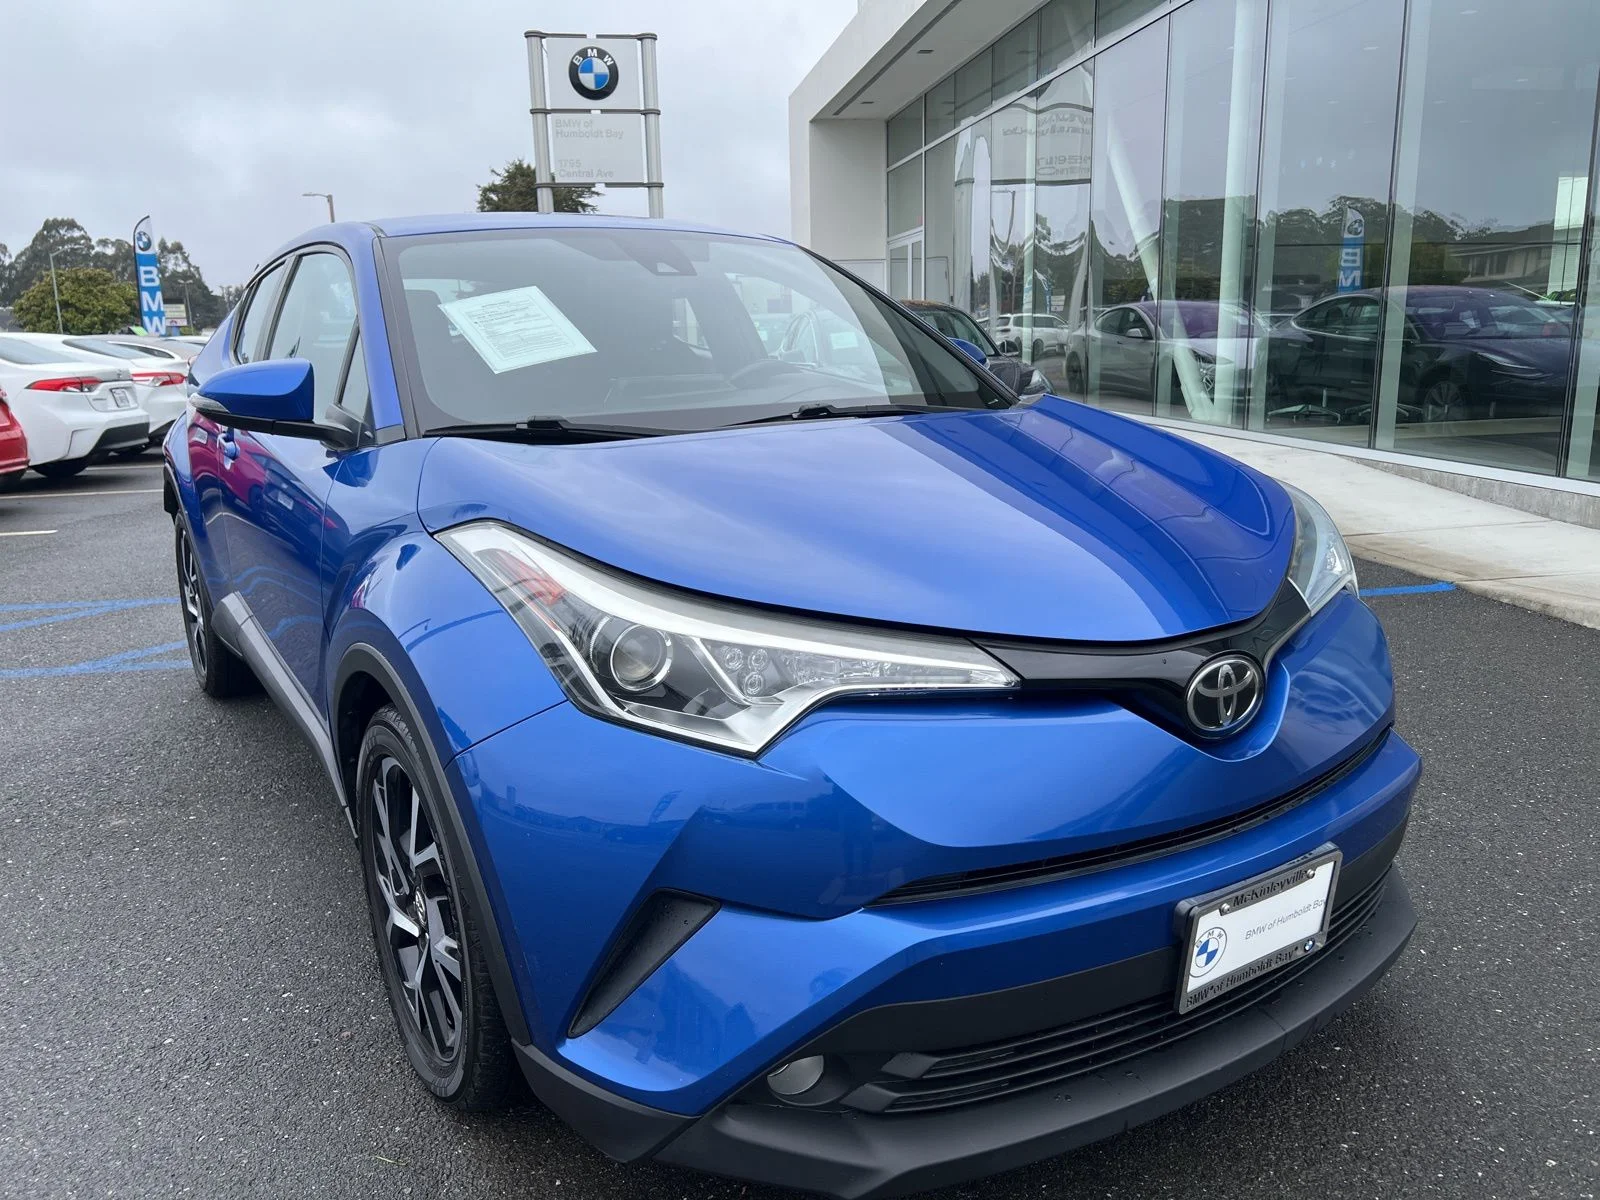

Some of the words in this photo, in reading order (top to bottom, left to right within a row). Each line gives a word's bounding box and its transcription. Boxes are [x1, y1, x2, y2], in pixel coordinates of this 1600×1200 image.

[573, 48, 613, 66] BMW
[555, 119, 581, 128] BMW
[583, 118, 593, 128] of
[555, 129, 604, 138] Humboldt
[606, 129, 624, 139] Bay
[559, 168, 593, 178] Central
[596, 169, 613, 178] Ave
[139, 266, 167, 336] BMW
[1245, 923, 1267, 940] BMW
[1267, 918, 1278, 930] of
[1277, 903, 1312, 926] Humboldt
[1213, 979, 1225, 993] of
[1226, 958, 1274, 988] Humboldt
[1276, 949, 1295, 965] Bay
